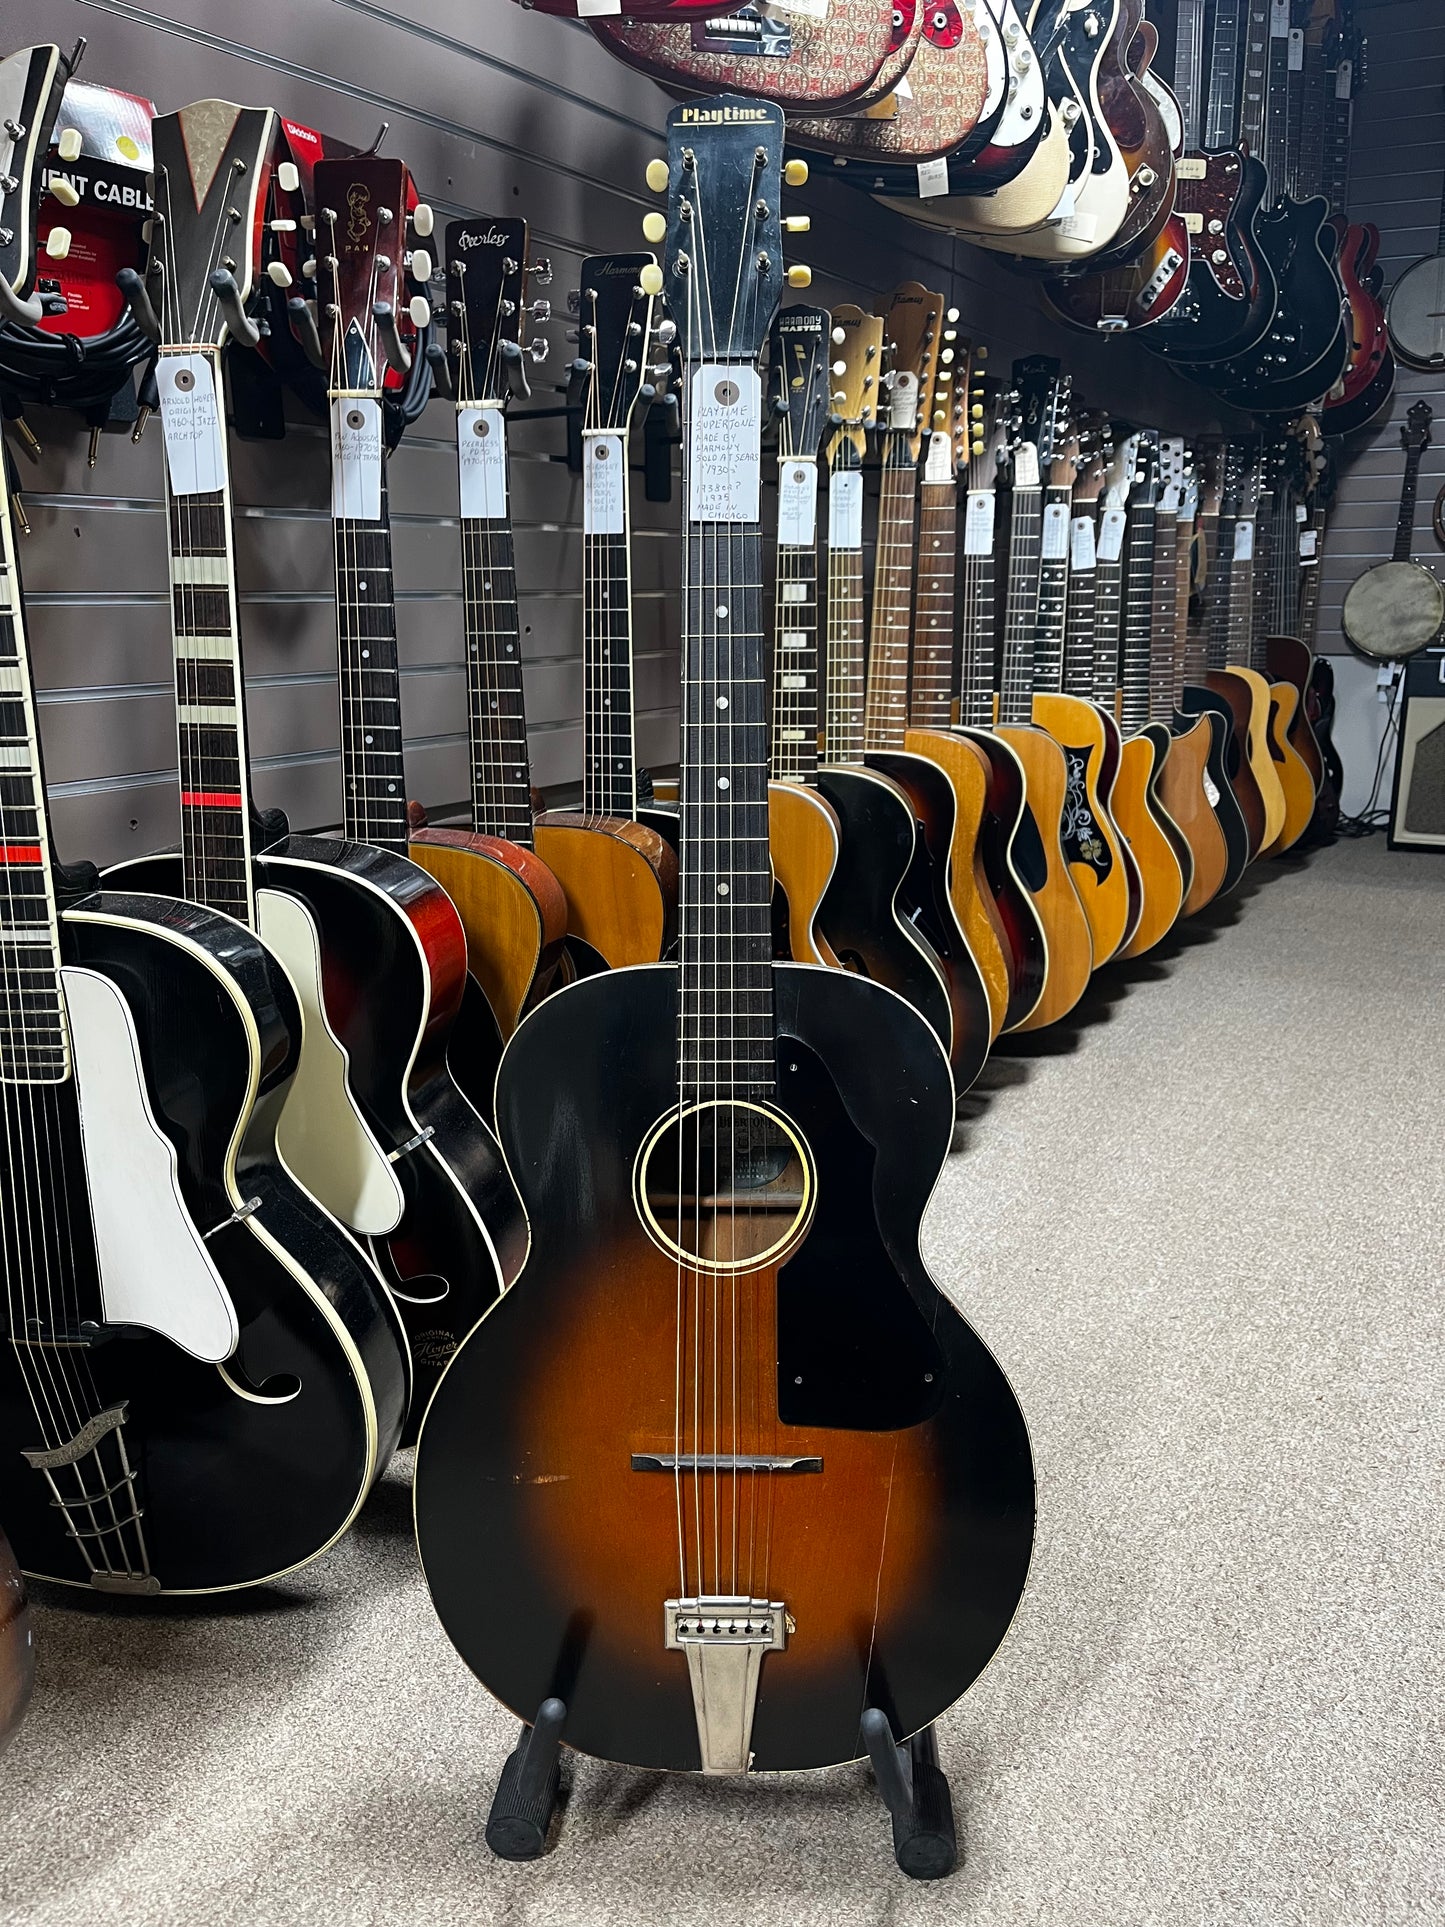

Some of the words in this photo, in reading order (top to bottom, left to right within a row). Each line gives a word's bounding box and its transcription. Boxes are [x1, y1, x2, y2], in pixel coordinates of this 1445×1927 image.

[682, 106, 767, 124] Playtime
[345, 244, 369, 253] PAN
[779, 315, 822, 327] HARMONY
[779, 325, 822, 333] MASTER
[698, 405, 748, 418] PLAYTIME
[696, 416, 756, 432] SUPERTONE
[168, 430, 204, 441] ARCHTOP
[696, 433, 720, 442] MADE
[723, 433, 737, 443] BY
[696, 443, 741, 453] HARMONY
[696, 454, 718, 463] SOLD
[720, 453, 734, 462] AT
[734, 452, 760, 463] SEARS
[697, 503, 722, 512] MADE
[708, 512, 749, 520] CHICAGO
[414, 1329, 455, 1341] ORIGINAL
